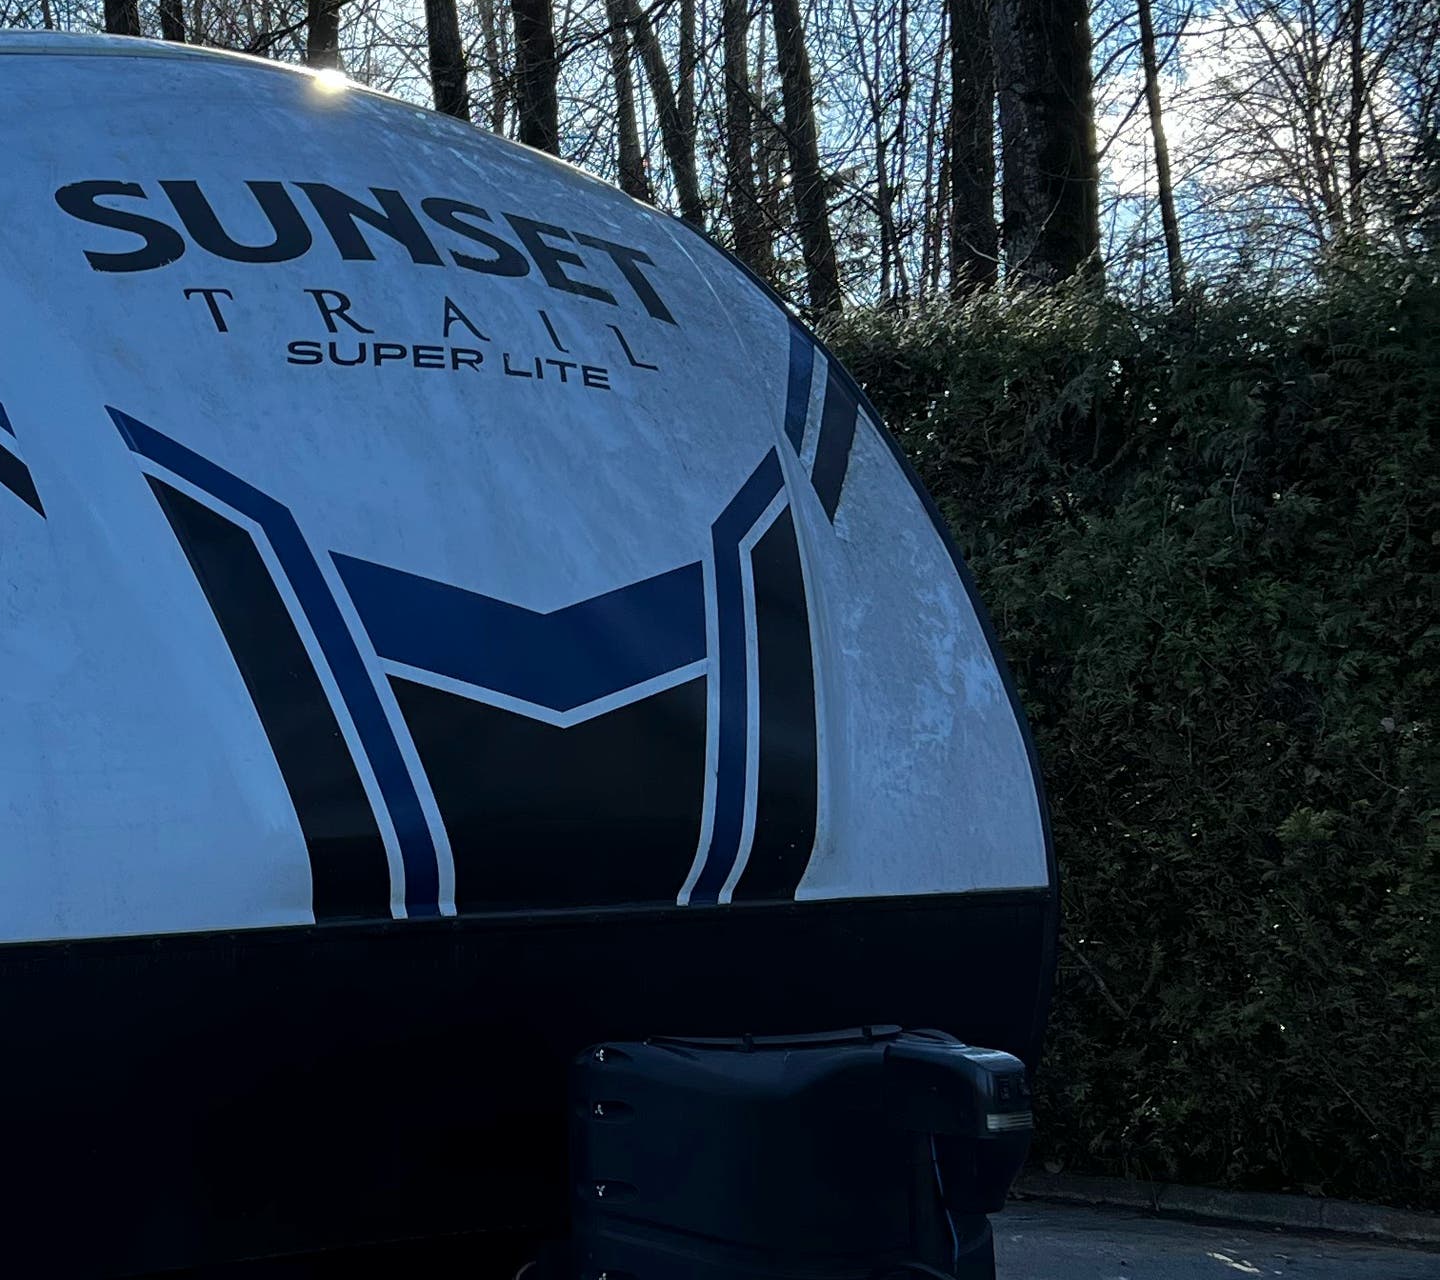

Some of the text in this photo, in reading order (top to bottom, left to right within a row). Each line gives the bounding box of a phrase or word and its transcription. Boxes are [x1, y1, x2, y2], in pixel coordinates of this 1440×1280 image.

[55, 179, 679, 327] SUNSET
[183, 287, 659, 371] TRAIL
[286, 340, 612, 391] SUPER LITE
